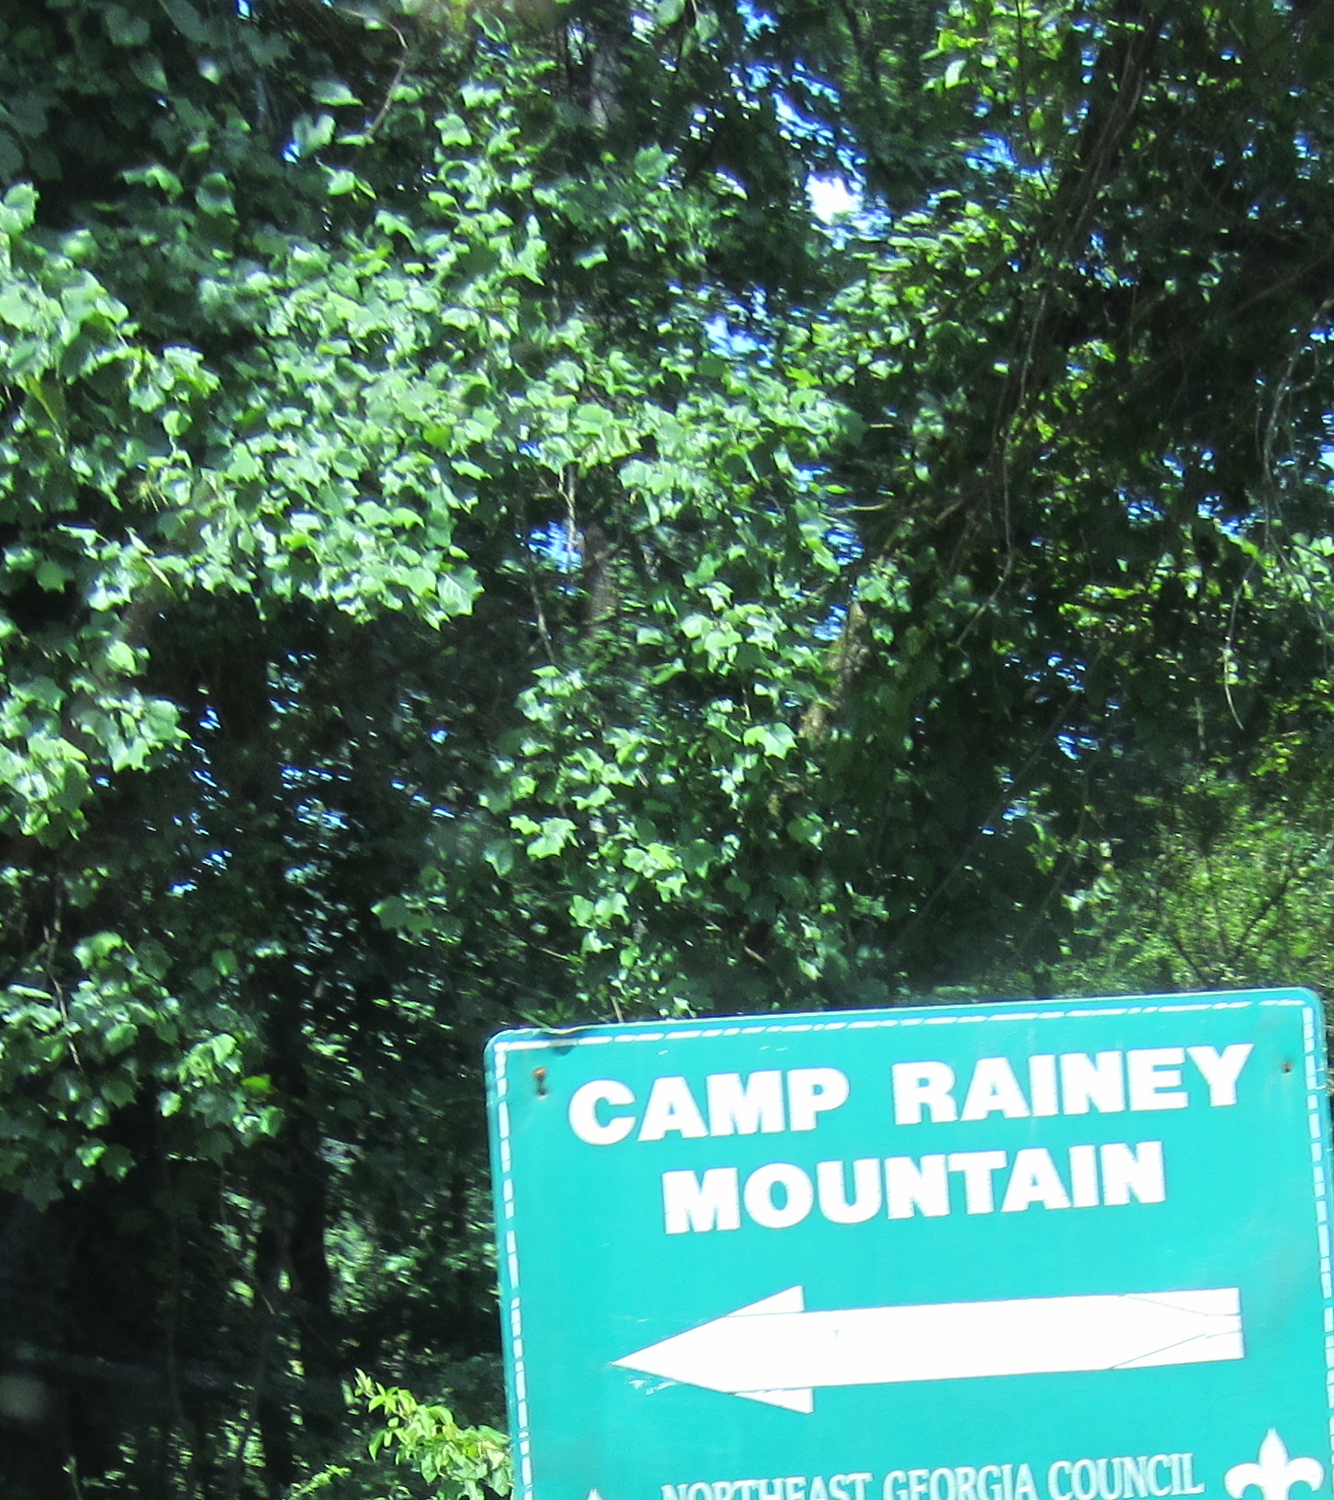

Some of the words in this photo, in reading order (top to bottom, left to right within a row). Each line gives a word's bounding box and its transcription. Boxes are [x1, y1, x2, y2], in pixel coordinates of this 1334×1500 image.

[568, 1068, 850, 1145] CAMP
[892, 1043, 1254, 1126] RAINEY
[662, 1141, 1166, 1235] MOUNTAIN
